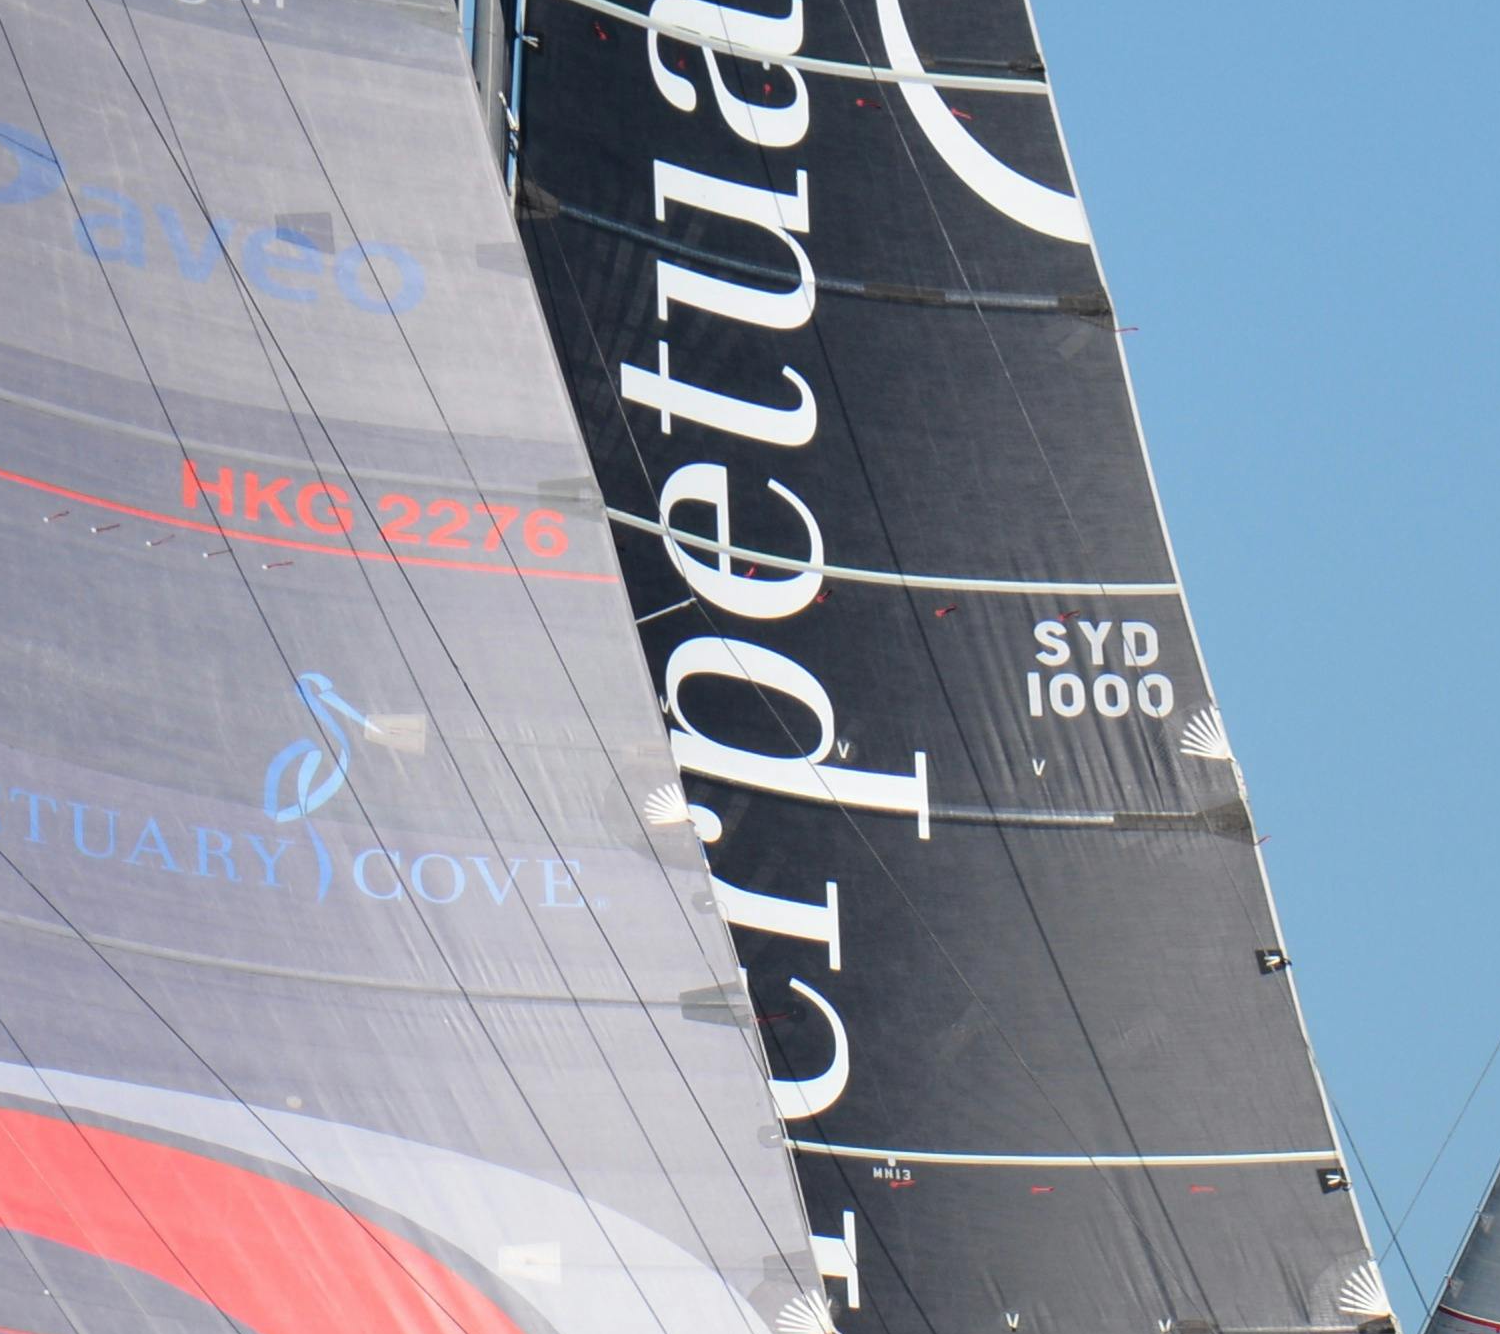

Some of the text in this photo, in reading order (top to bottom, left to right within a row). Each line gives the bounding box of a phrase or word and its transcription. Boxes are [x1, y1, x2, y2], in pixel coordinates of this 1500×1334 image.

[73, 184, 427, 315] aveo
[182, 459, 570, 559] HKG 2276
[1033, 620, 1159, 667] SYD
[1027, 671, 1175, 718] 1000
[352, 847, 586, 908] COVE
